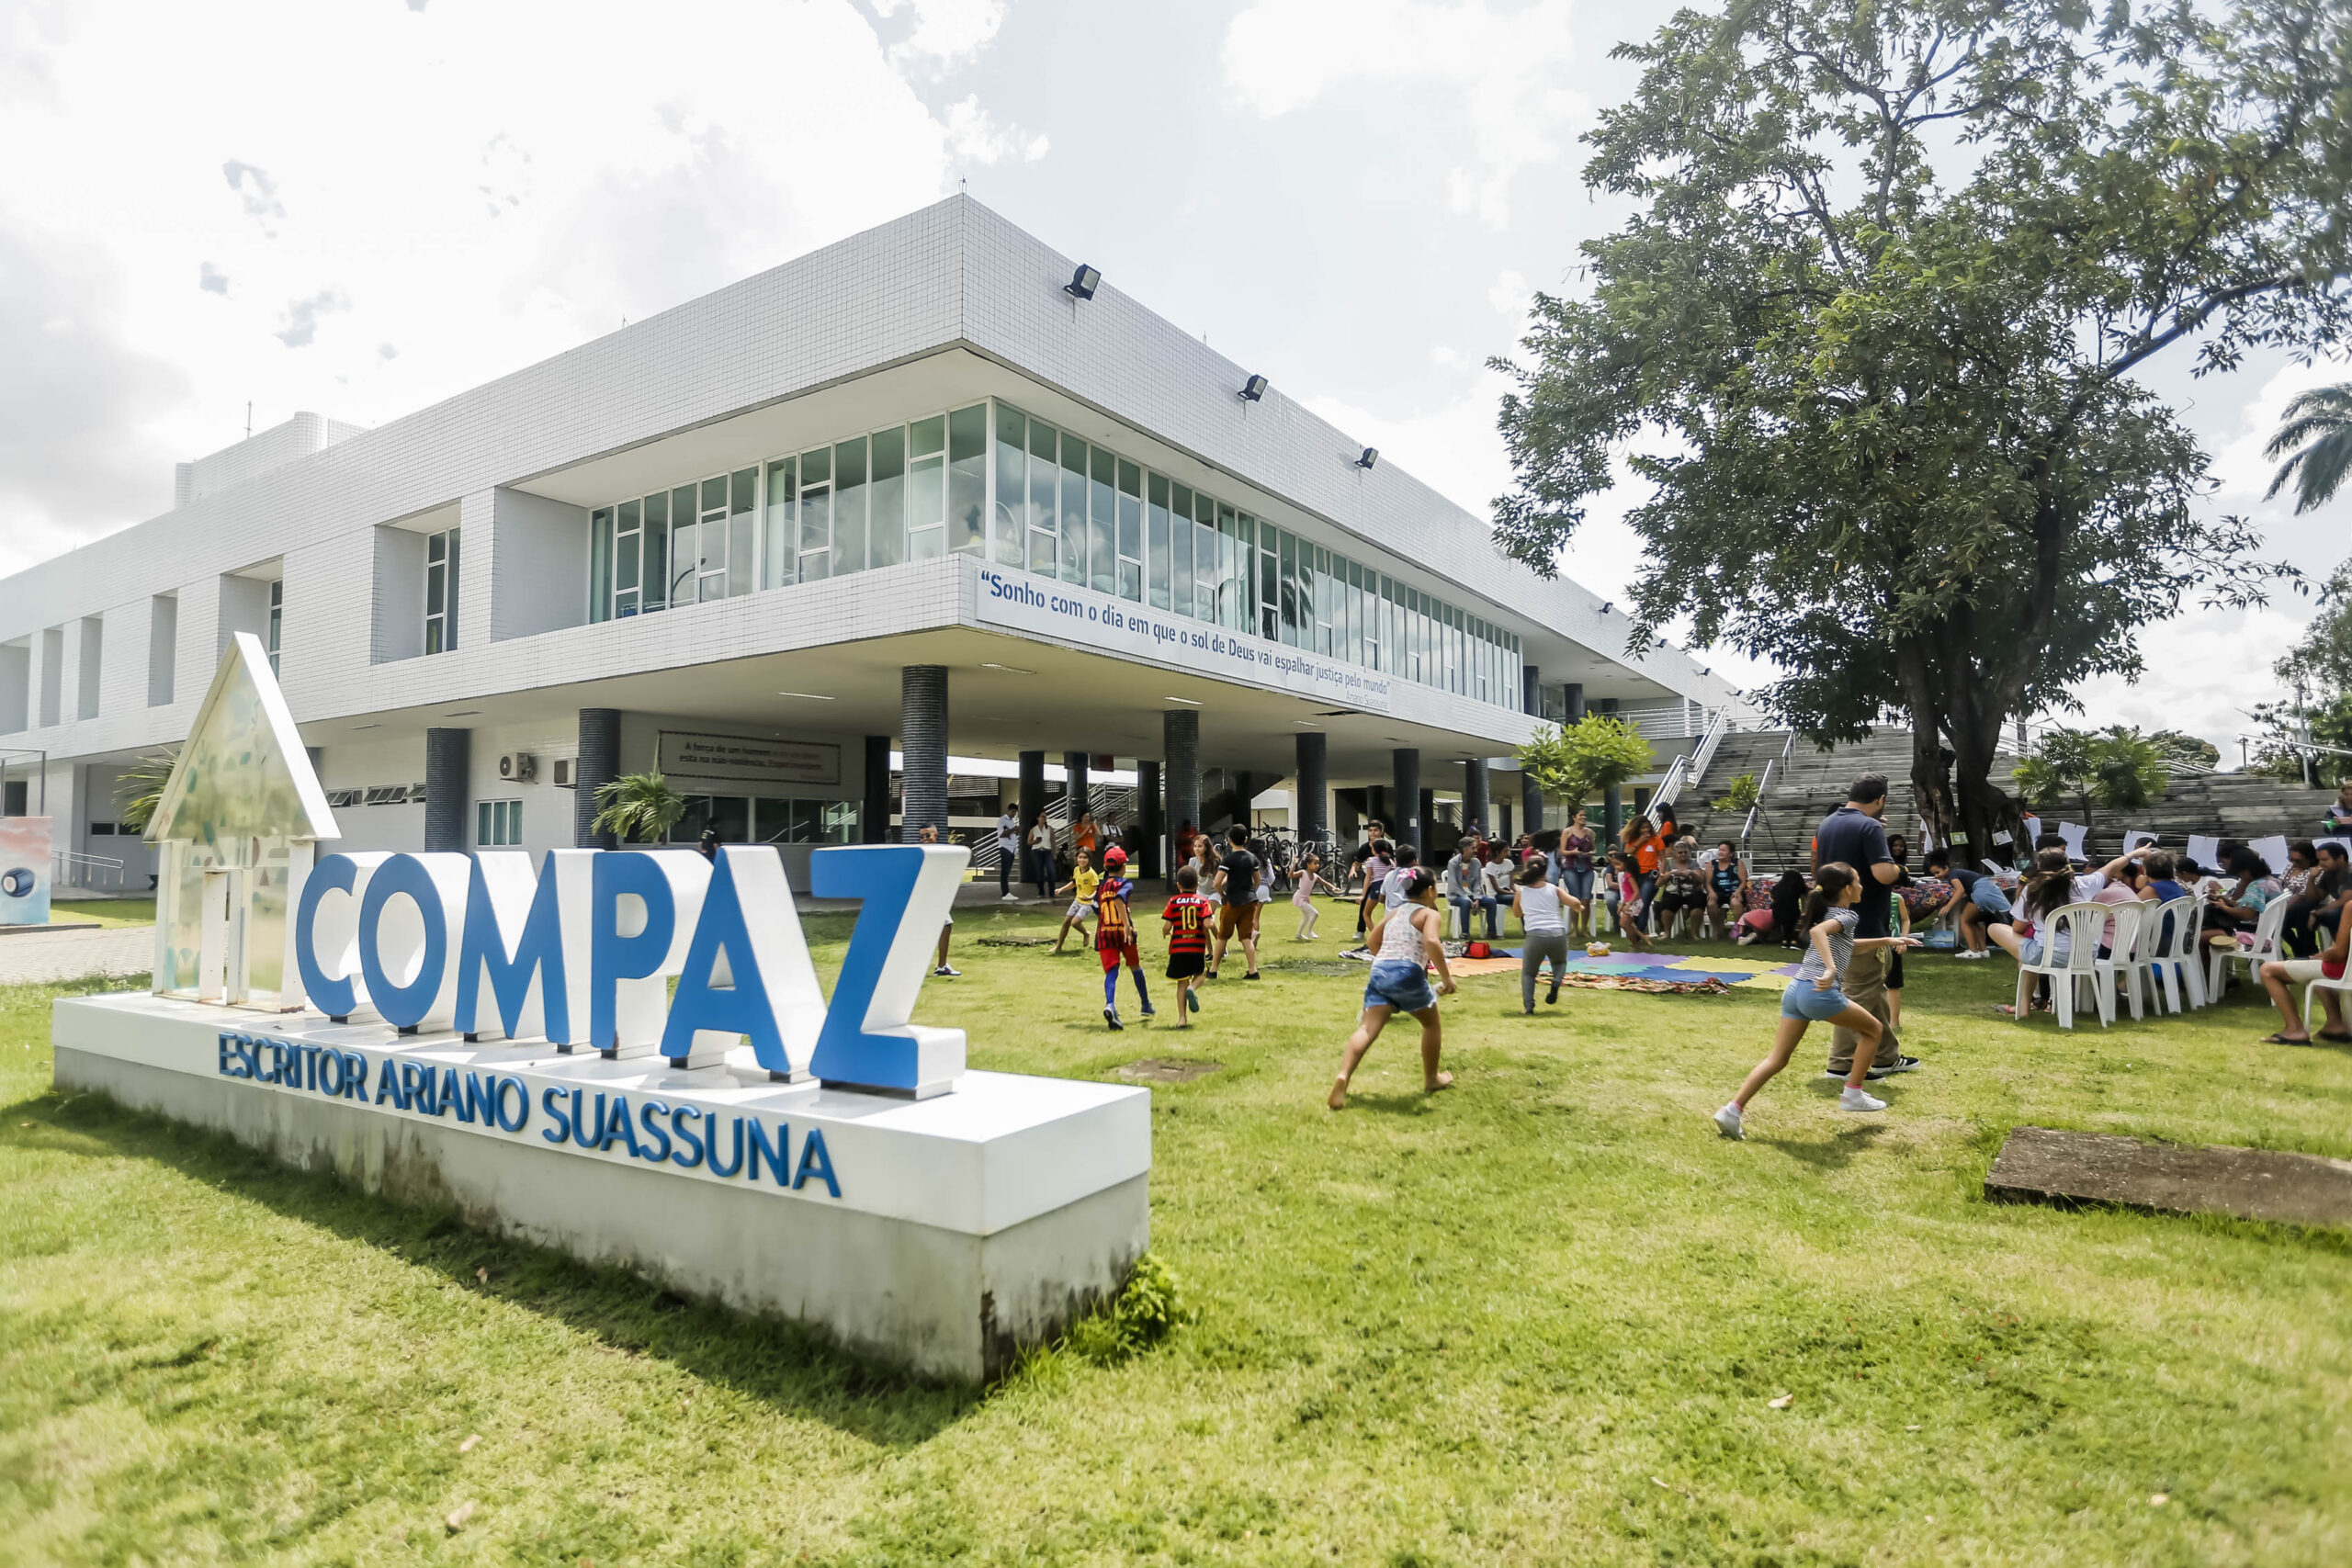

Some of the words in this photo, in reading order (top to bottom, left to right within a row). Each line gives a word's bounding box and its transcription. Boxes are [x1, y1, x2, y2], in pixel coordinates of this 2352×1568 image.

[1051, 596, 1083, 618] com
[1088, 605, 1097, 621] o
[1102, 604, 1124, 628] dia
[1128, 616, 1149, 635] em
[1153, 622, 1176, 645] que
[1181, 630, 1188, 644] o
[1191, 631, 1209, 650] sol
[1212, 634, 1226, 654] de
[1228, 638, 1255, 661] Deus
[1257, 649, 1272, 667] vai
[1274, 656, 1315, 677] espalhar
[1316, 661, 1343, 687] justiça
[1345, 671, 1362, 689] pelo
[1175, 897, 1202, 905] CAIXA
[1179, 905, 1198, 931] 10
[295, 844, 970, 1092] COMPAZ
[218, 1032, 368, 1103] ESCRITOR
[376, 1058, 530, 1133] ARIANO
[541, 1085, 843, 1199] SUASSUNA
